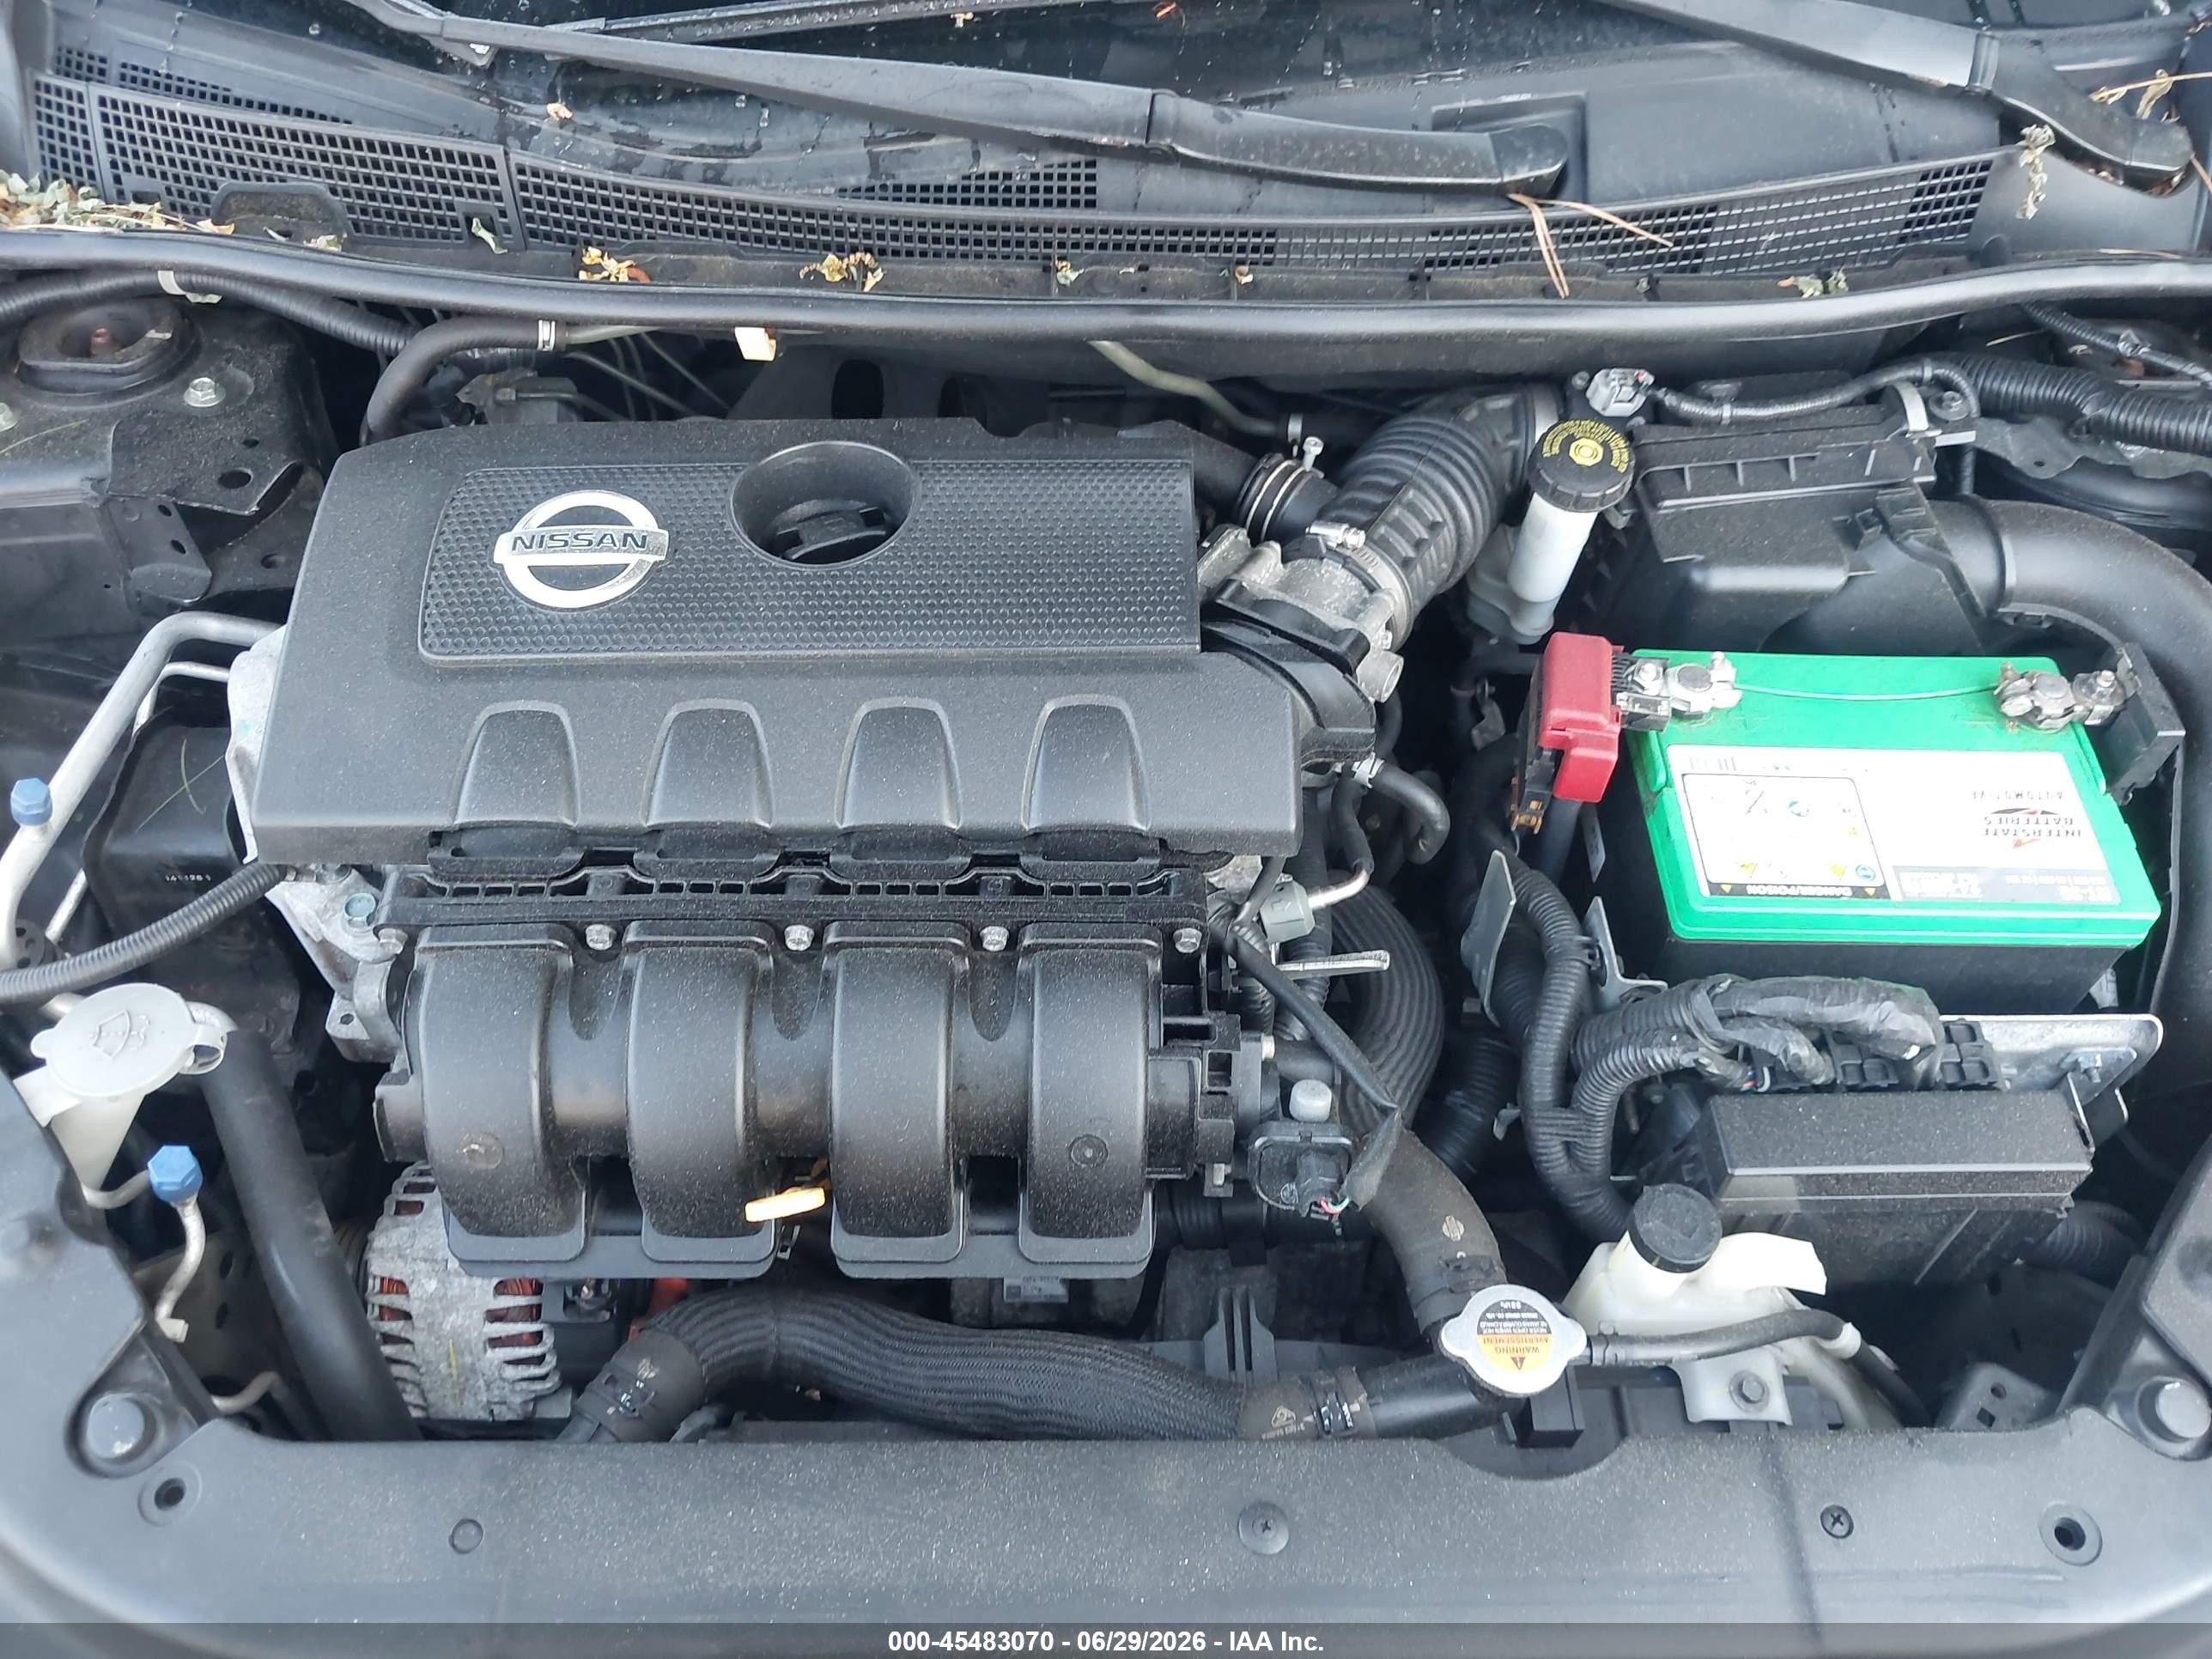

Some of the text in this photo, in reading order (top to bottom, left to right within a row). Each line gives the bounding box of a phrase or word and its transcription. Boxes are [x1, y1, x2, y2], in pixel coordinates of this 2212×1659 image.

[512, 532, 648, 551] NISSAN
[1984, 817, 2073, 825] BATTERIES
[1984, 828, 2081, 837] INTERSTATE
[1494, 1346, 1540, 1354] WARNING
